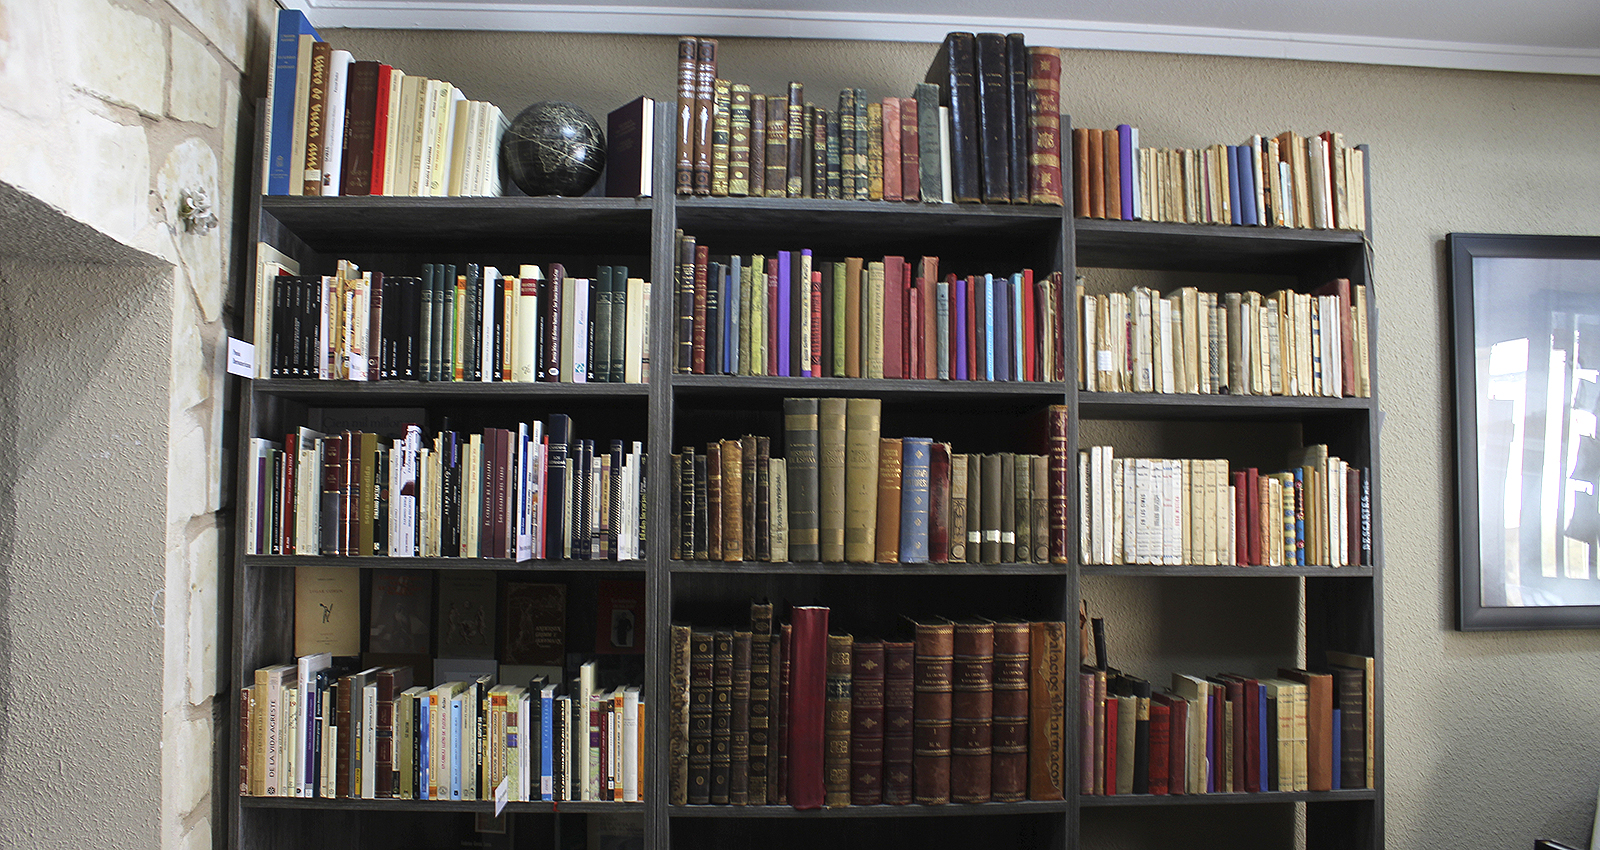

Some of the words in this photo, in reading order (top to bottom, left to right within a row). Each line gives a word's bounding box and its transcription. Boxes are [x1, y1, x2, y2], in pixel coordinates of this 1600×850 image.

[1361, 495, 1372, 550] DESCARTES
[269, 754, 275, 765] LA
[269, 767, 275, 778] DE
